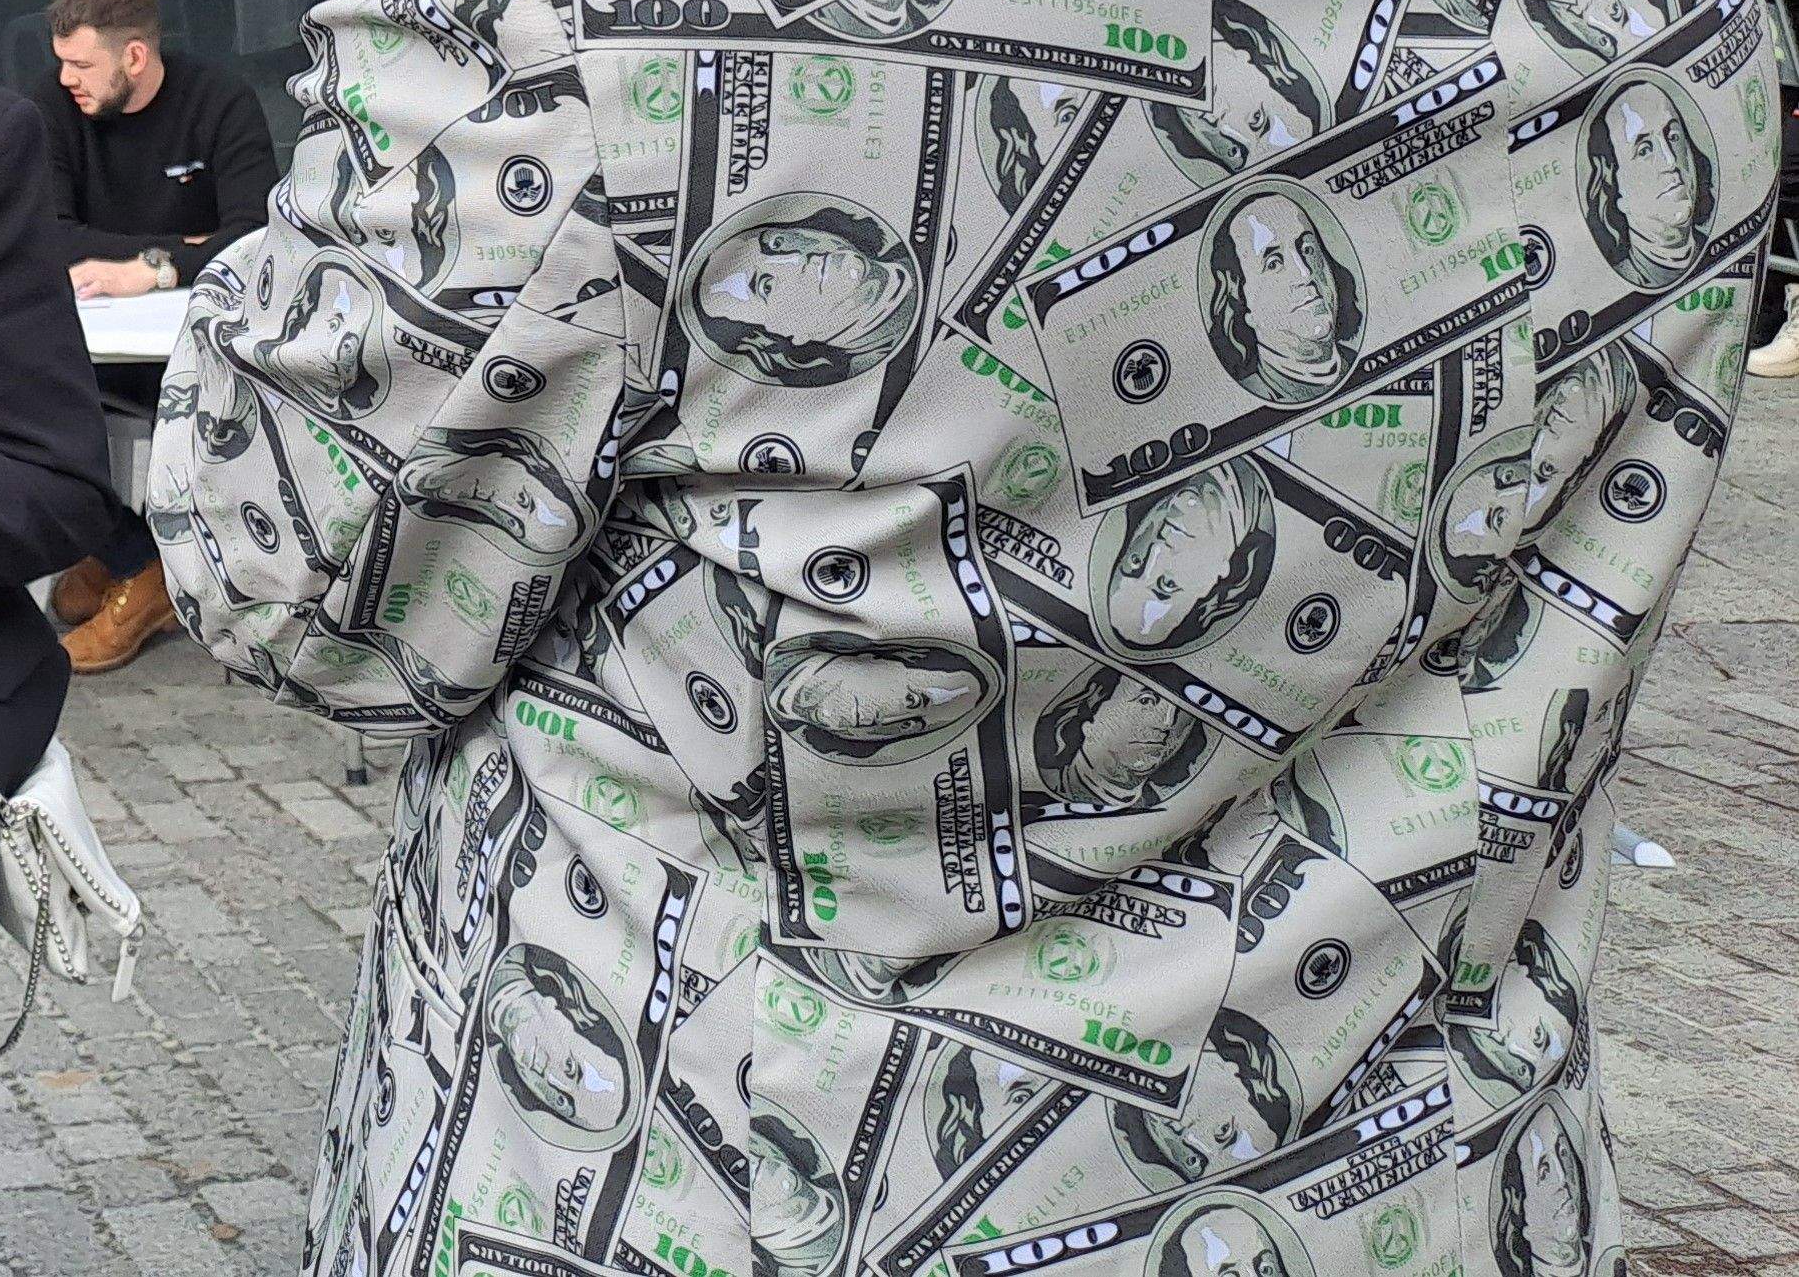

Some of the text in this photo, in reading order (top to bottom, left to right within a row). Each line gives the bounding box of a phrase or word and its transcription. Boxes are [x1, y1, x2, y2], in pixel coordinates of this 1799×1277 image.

[930, 34, 1193, 89] ONE HUNDRED DOLLARS
[1104, 23, 1188, 61] 100
[1394, 56, 1505, 128] 100
[1053, 222, 1175, 295] 100
[515, 700, 578, 742] 100
[1081, 1019, 1173, 1066] 100
[977, 1222, 1119, 1275] 100
